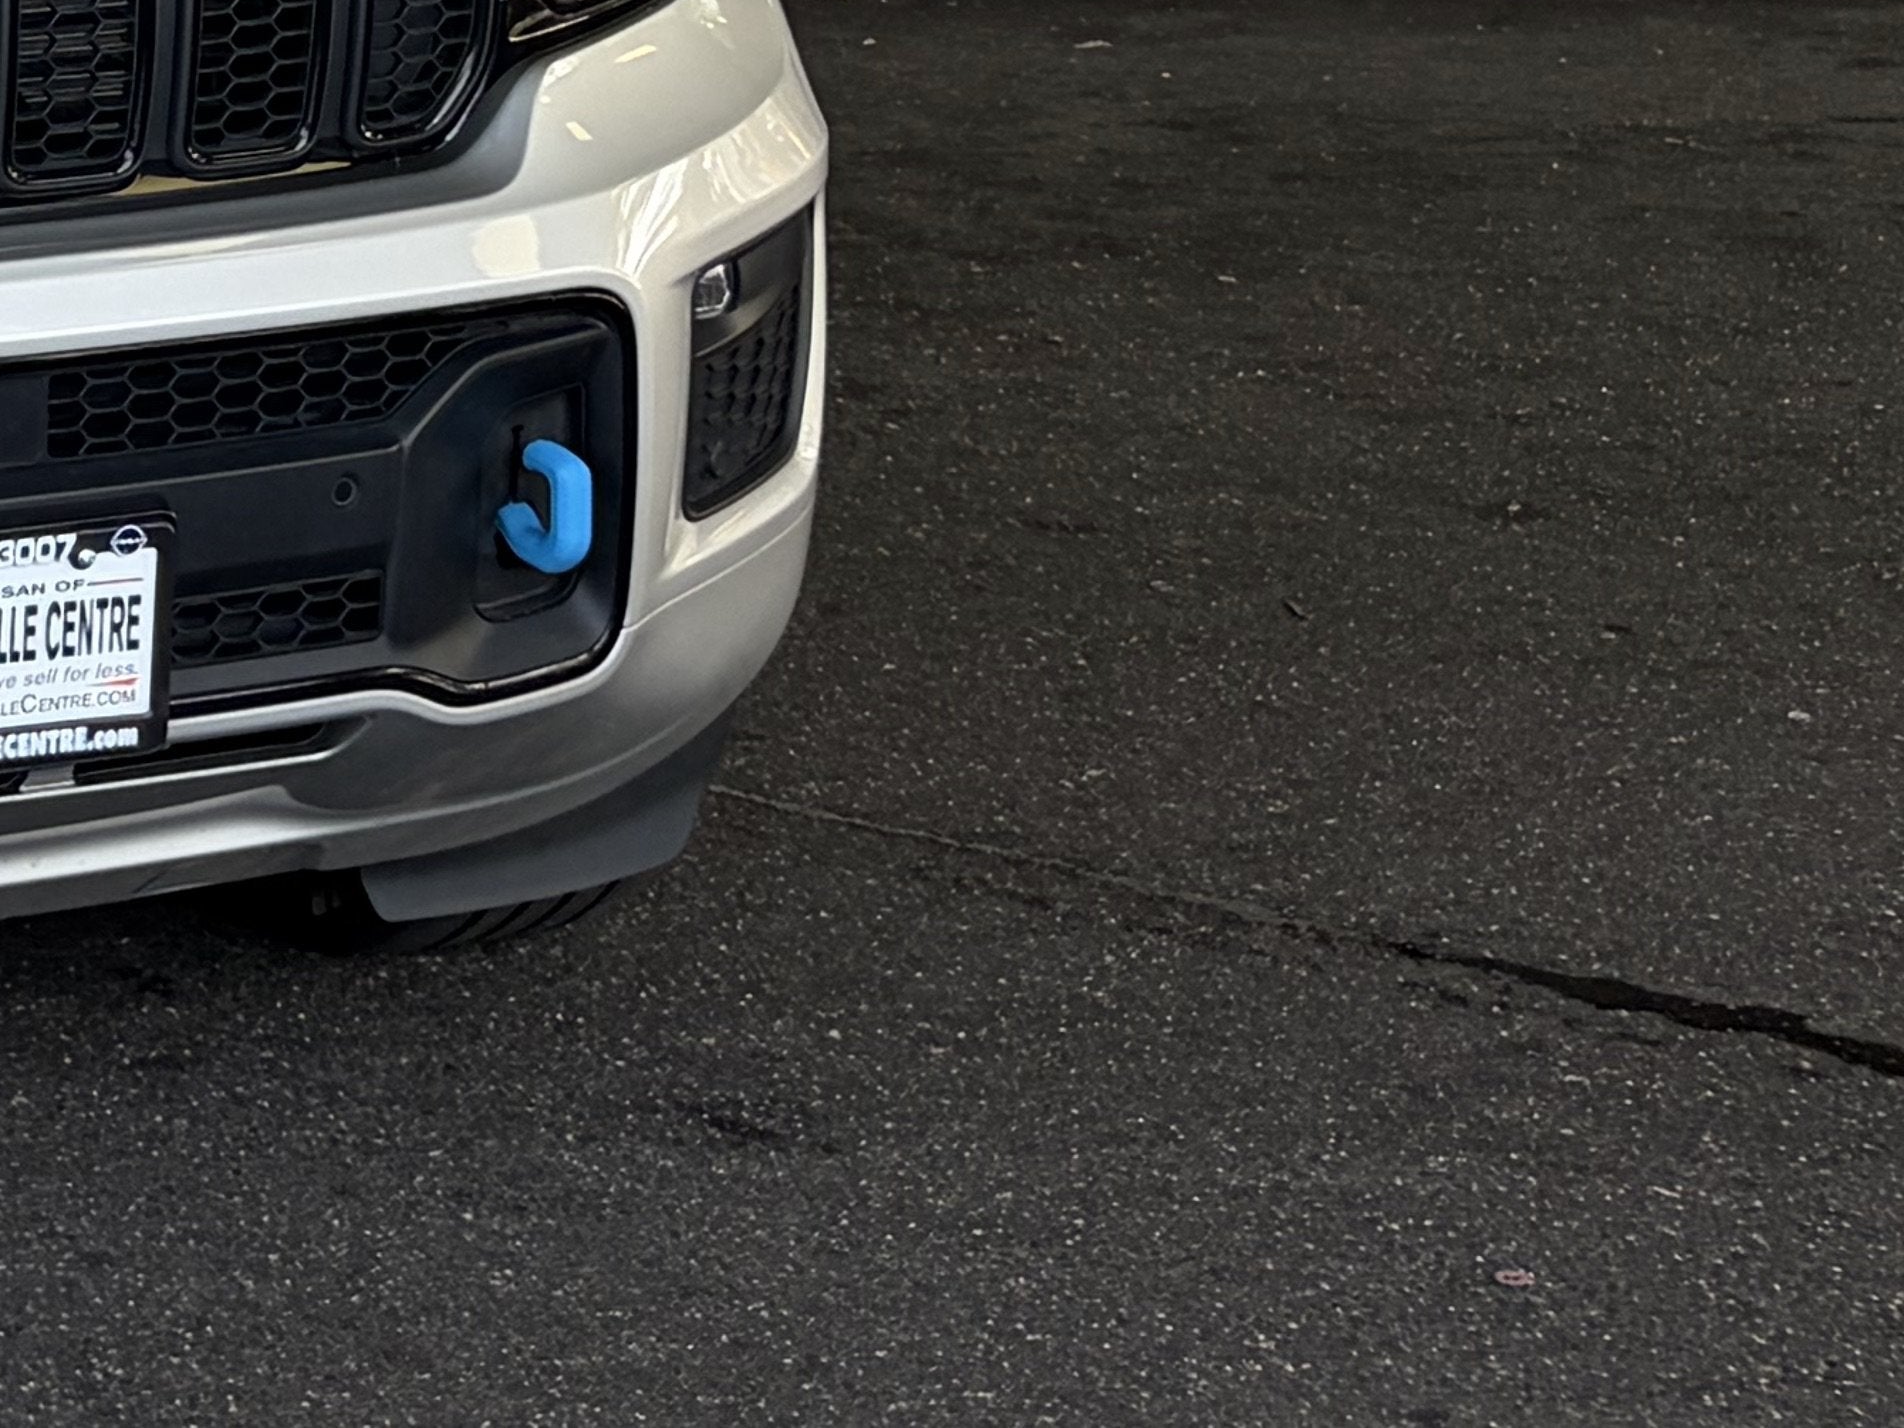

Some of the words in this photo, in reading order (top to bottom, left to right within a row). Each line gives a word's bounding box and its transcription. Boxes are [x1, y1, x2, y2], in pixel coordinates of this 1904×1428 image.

[55, 579, 87, 593] OF
[45, 594, 142, 660] CENTRE
[23, 667, 58, 687] sell
[63, 666, 90, 683] for
